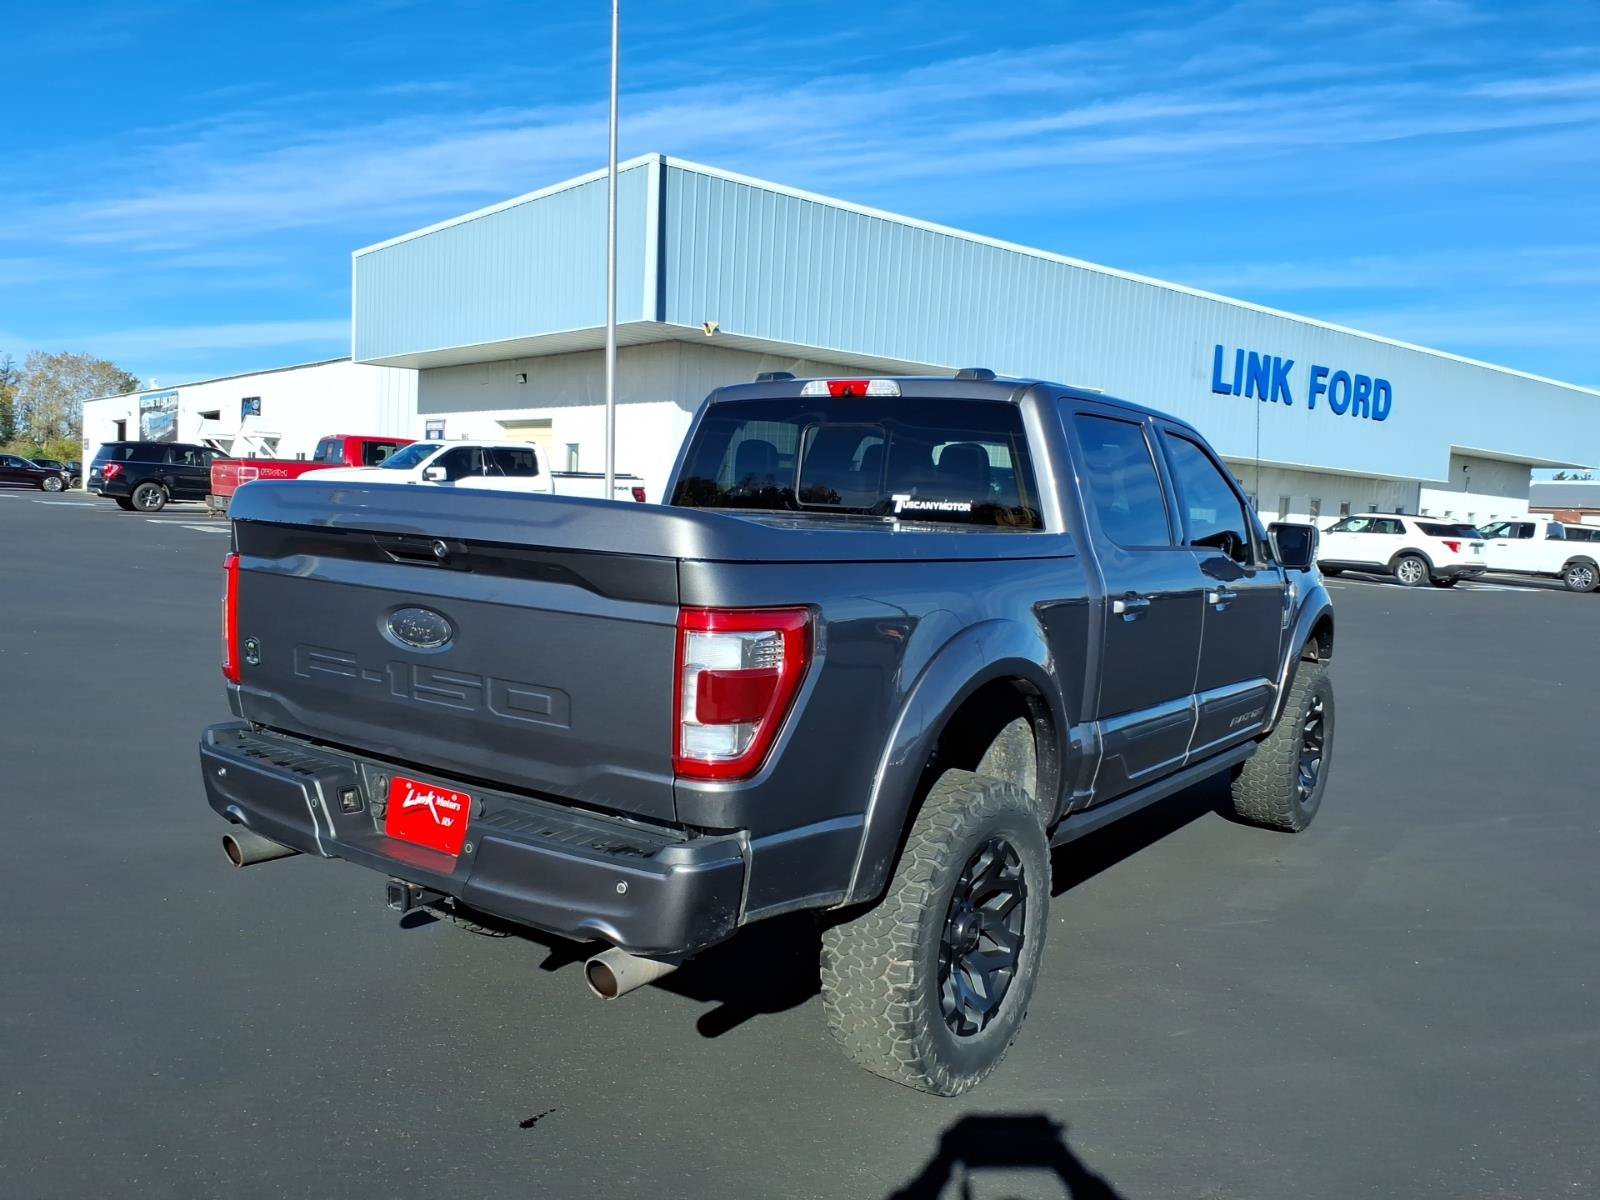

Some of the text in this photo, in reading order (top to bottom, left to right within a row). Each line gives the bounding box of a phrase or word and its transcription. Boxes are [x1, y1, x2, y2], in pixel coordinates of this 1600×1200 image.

[1211, 344, 1393, 422] LINK FORD
[293, 642, 573, 730] F-150
[402, 788, 462, 824] Link Motors
